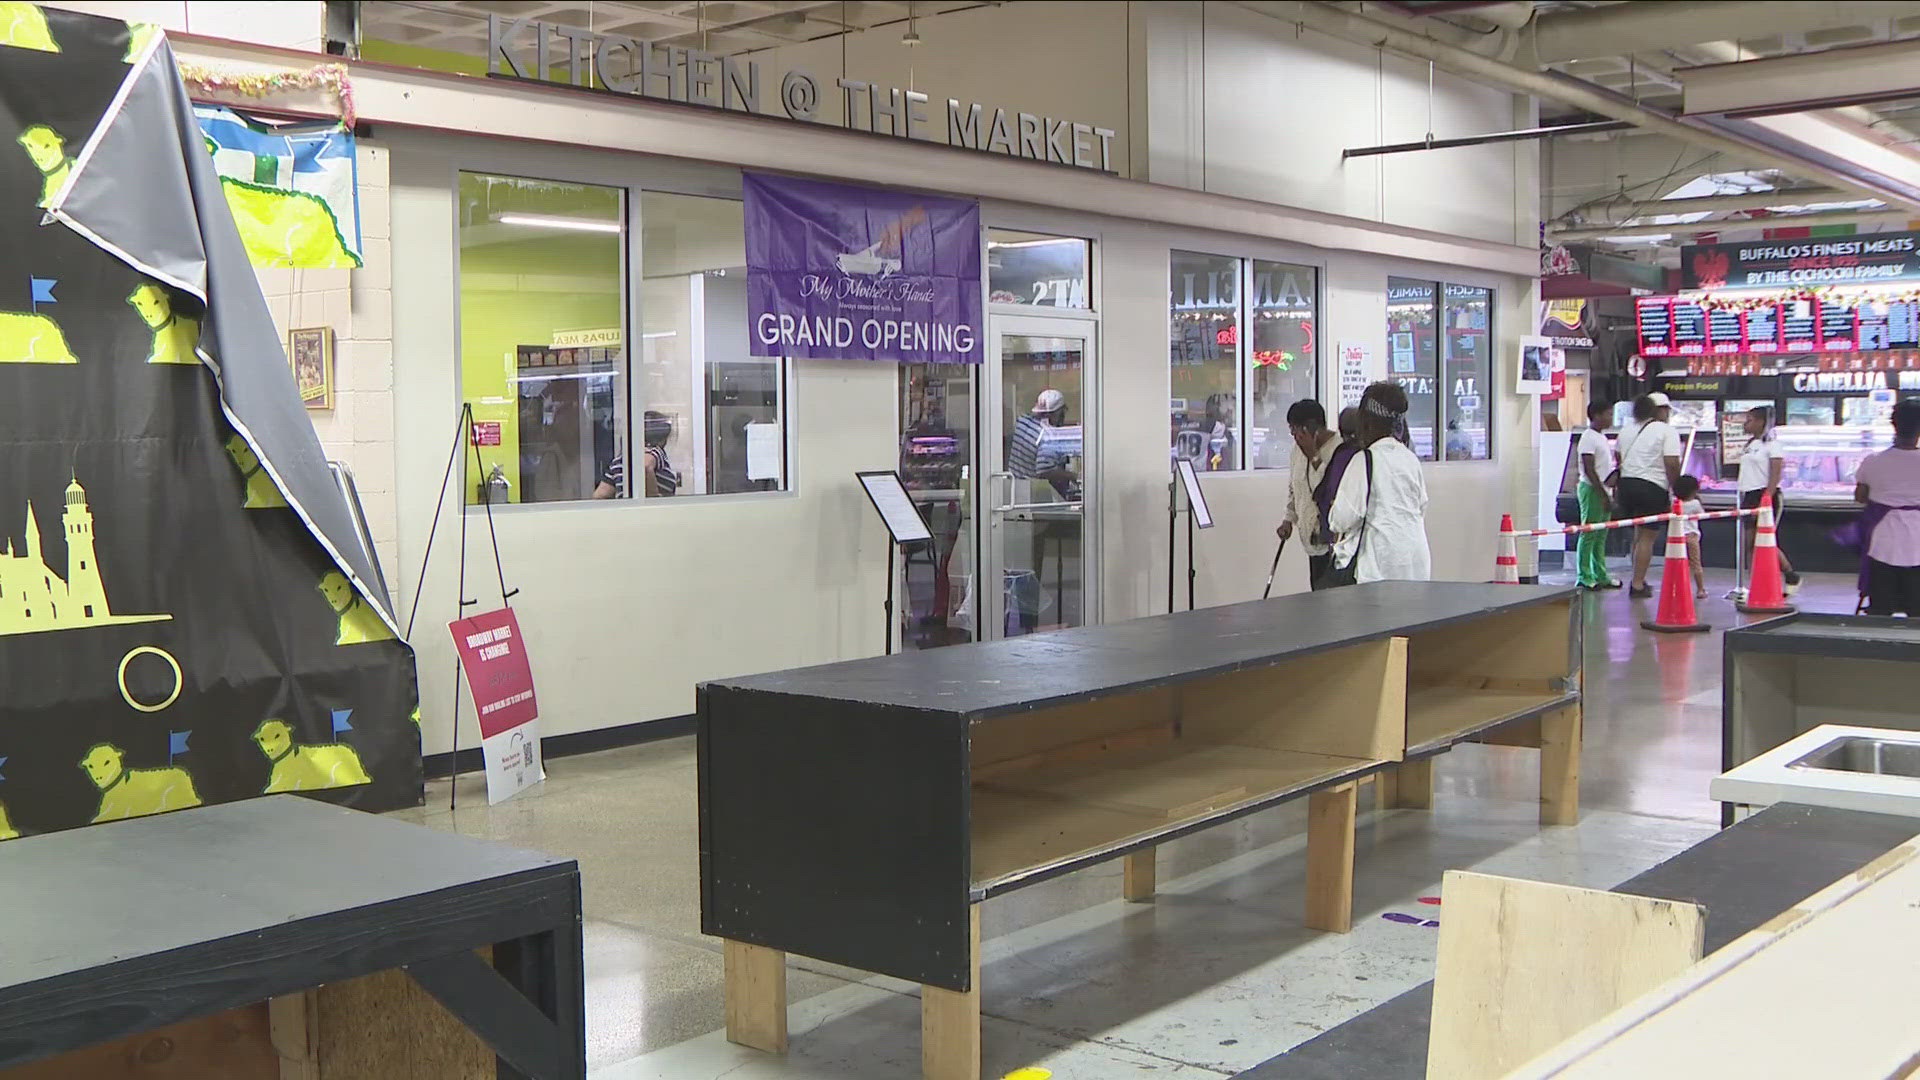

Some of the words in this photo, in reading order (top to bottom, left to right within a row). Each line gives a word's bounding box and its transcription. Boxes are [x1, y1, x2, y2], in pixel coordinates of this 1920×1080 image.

[488, 13, 759, 113] KITCHEN
[781, 71, 821, 120] @
[838, 78, 930, 141] THE
[947, 99, 1116, 171] MARKET
[1812, 241, 1862, 256] FINEST
[1863, 238, 1914, 254] MEATS
[1747, 271, 1764, 284] BY
[1764, 270, 1790, 283] THE
[1855, 263, 1906, 278] FAMILY
[800, 274, 834, 301] My
[836, 276, 894, 300] Mother's
[757, 313, 854, 348] GRAND
[861, 319, 975, 353] OPENING
[1664, 382, 1695, 392] Frozen
[1696, 381, 1720, 391] Food
[1793, 371, 1887, 392] CAMELLIA
